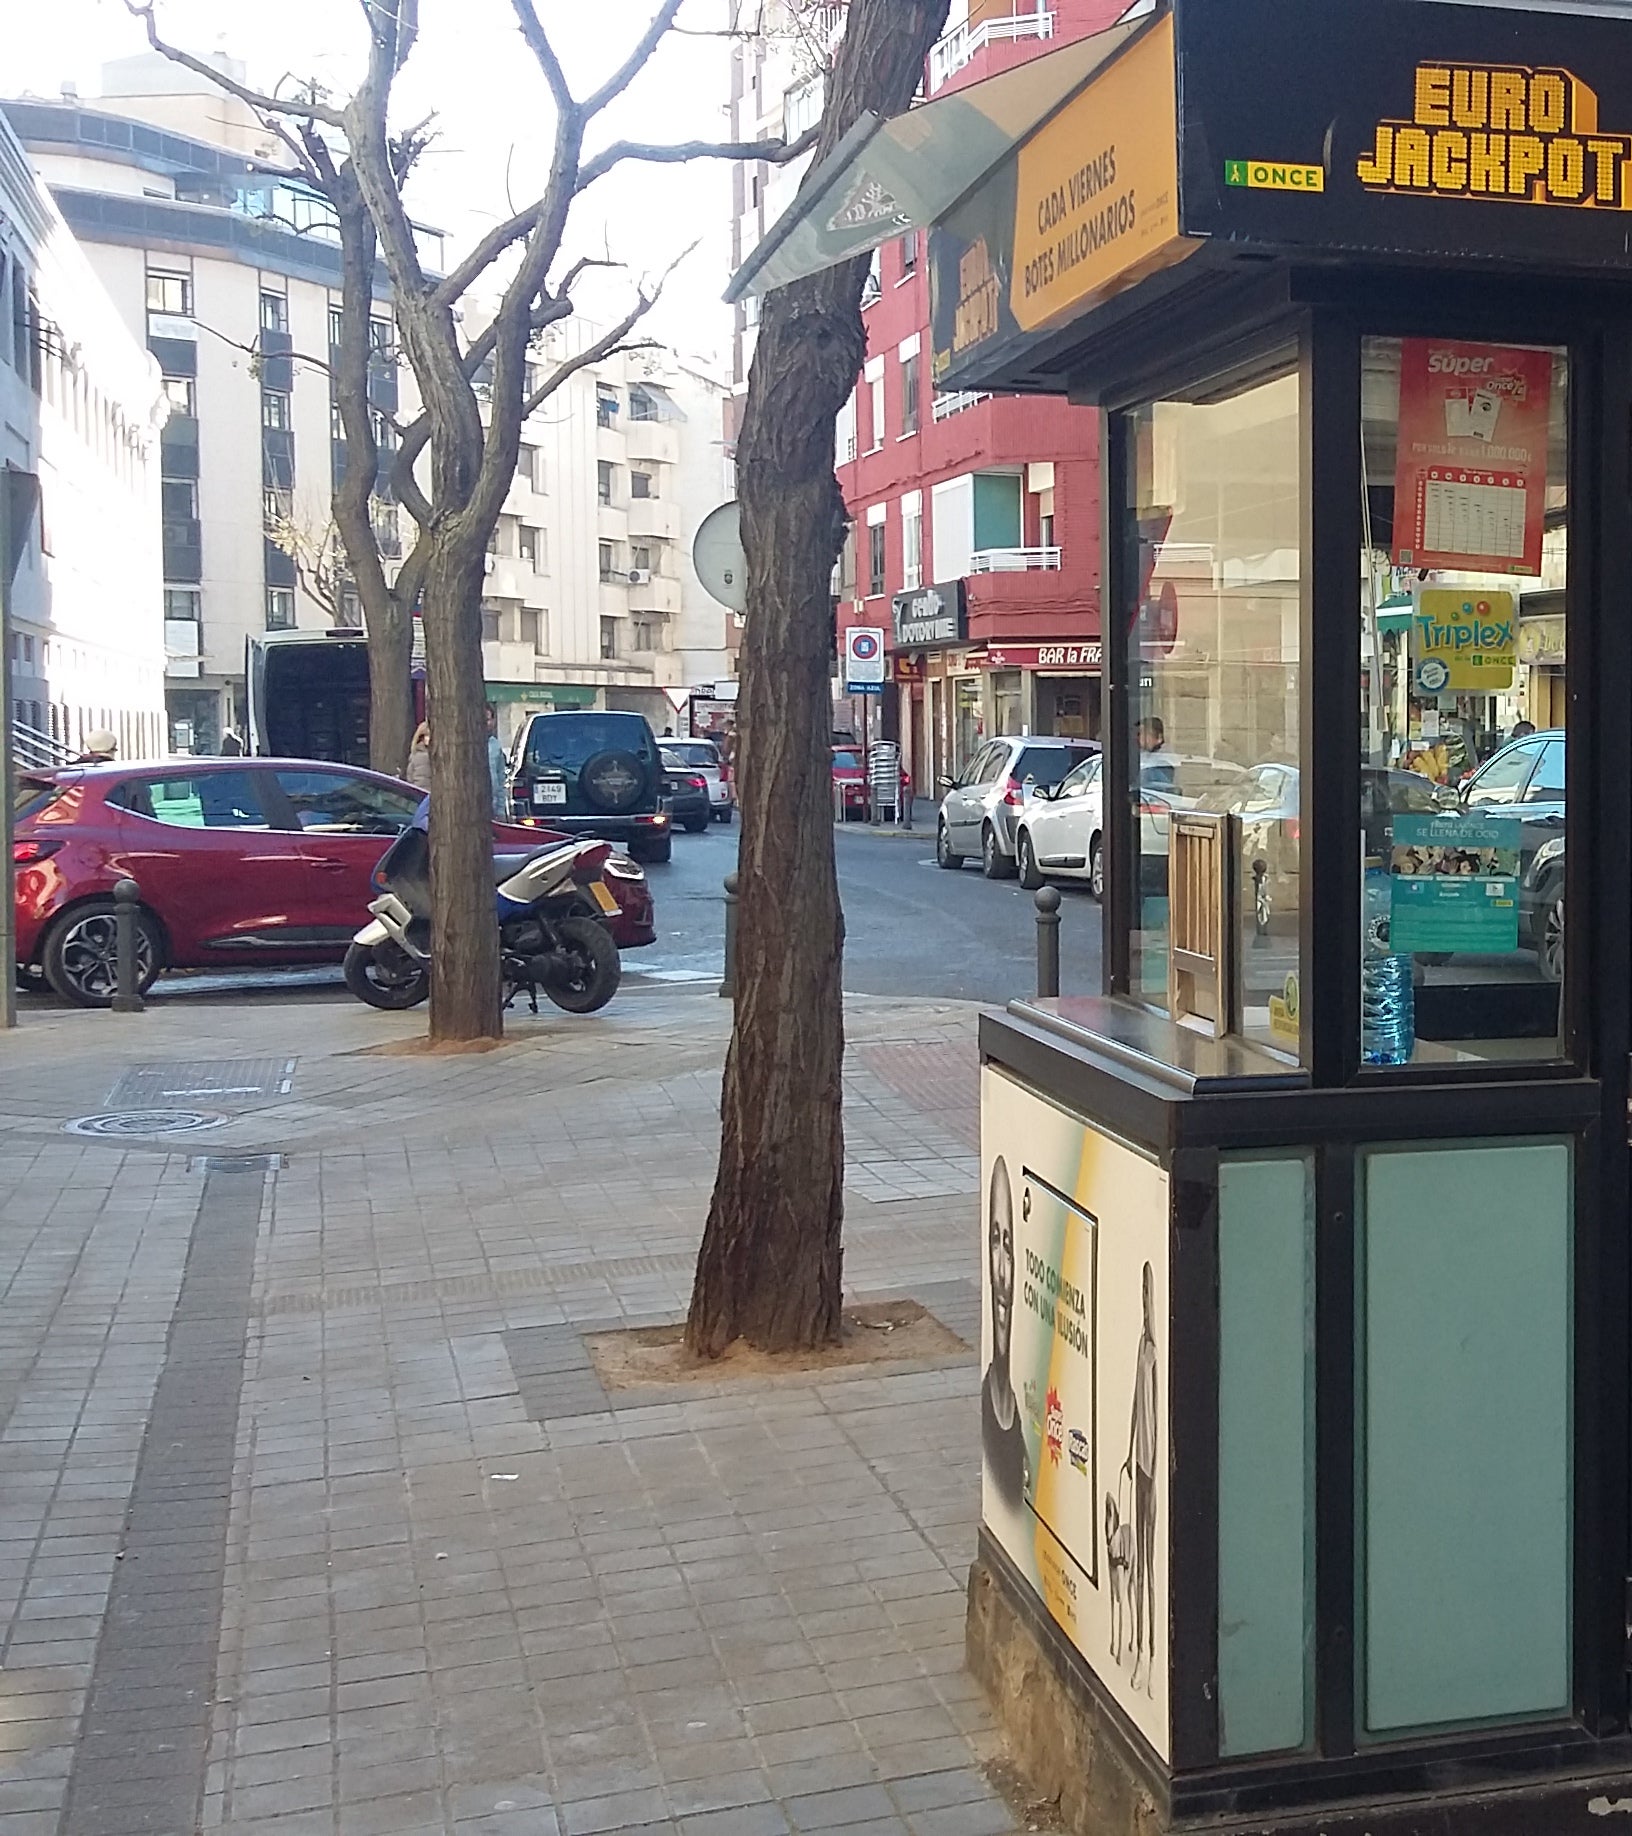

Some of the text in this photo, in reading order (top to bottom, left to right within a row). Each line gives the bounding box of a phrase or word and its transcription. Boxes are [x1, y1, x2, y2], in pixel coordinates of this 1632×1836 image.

[1414, 66, 1566, 133] EURO
[1037, 184, 1067, 236] CADA
[1069, 145, 1117, 212] VIERNES
[1253, 166, 1318, 188] ONCE
[1358, 126, 1624, 202] JACKPOT
[1025, 246, 1055, 299] BOTES
[1057, 189, 1136, 277] MILLONARIOS
[1039, 647, 1065, 664] BAR
[1067, 647, 1078, 664] la
[1416, 613, 1515, 651] Triplex
[1025, 1247, 1045, 1284] TODO
[1023, 1280, 1039, 1315] CON
[1057, 1310, 1088, 1359] ILUSIÓN
